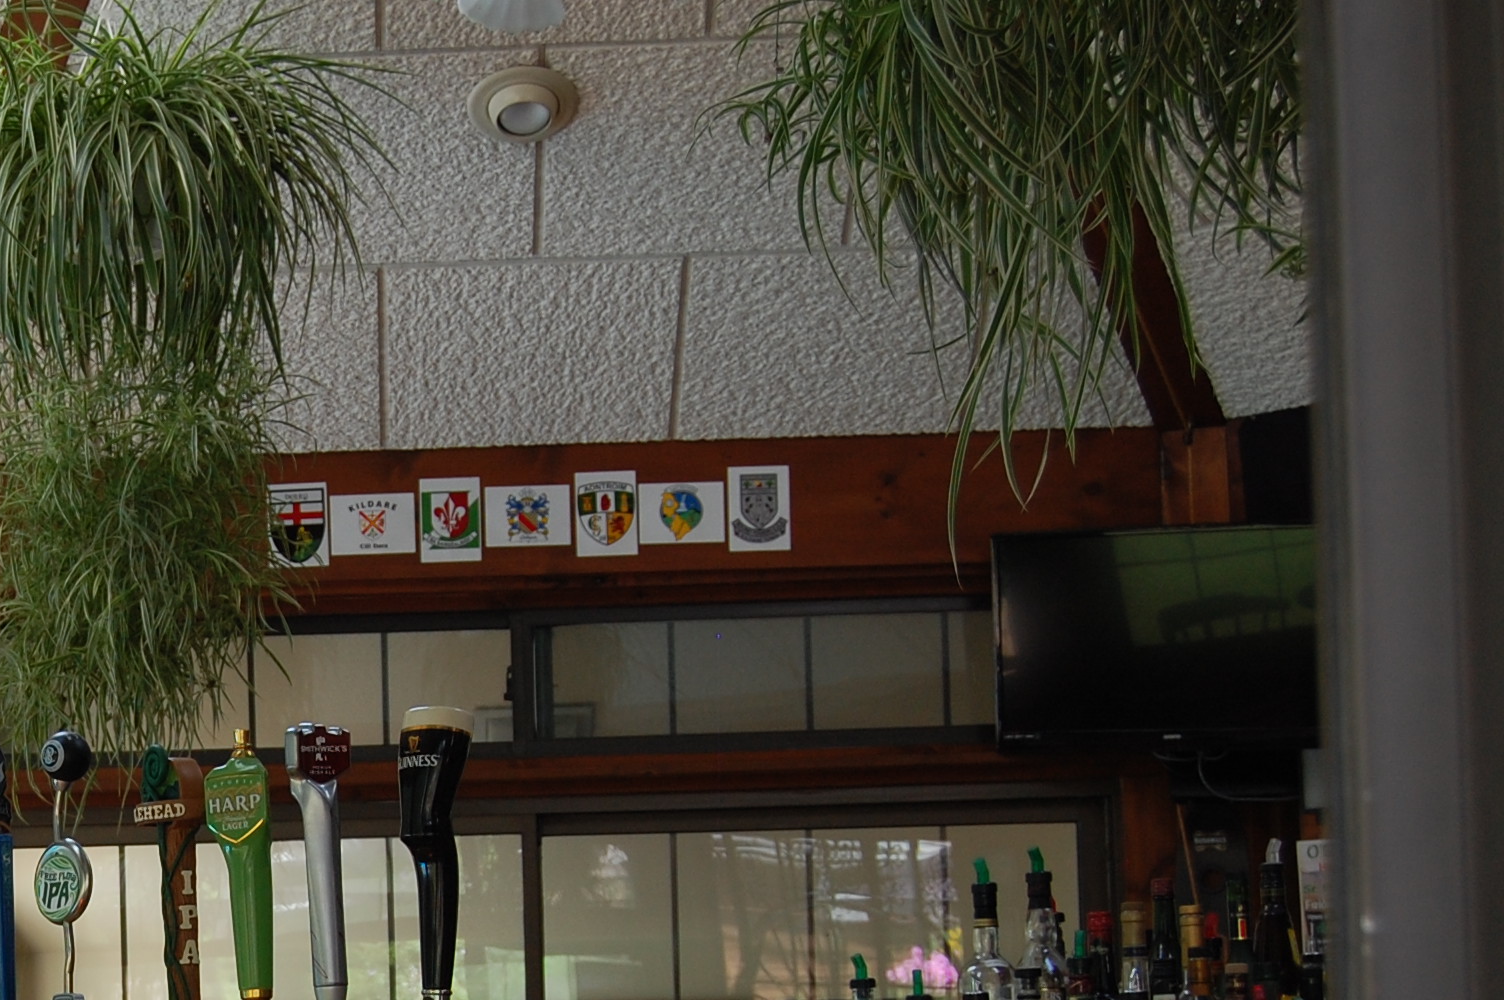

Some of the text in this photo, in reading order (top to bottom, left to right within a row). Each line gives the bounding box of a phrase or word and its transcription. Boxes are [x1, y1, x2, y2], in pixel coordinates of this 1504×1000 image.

[348, 500, 398, 513] KILDARE
[398, 754, 438, 770] UINNESS
[208, 793, 261, 814] HARP
[221, 821, 249, 831] LAGER
[42, 881, 70, 910] IPA
[179, 870, 201, 965] IPA
